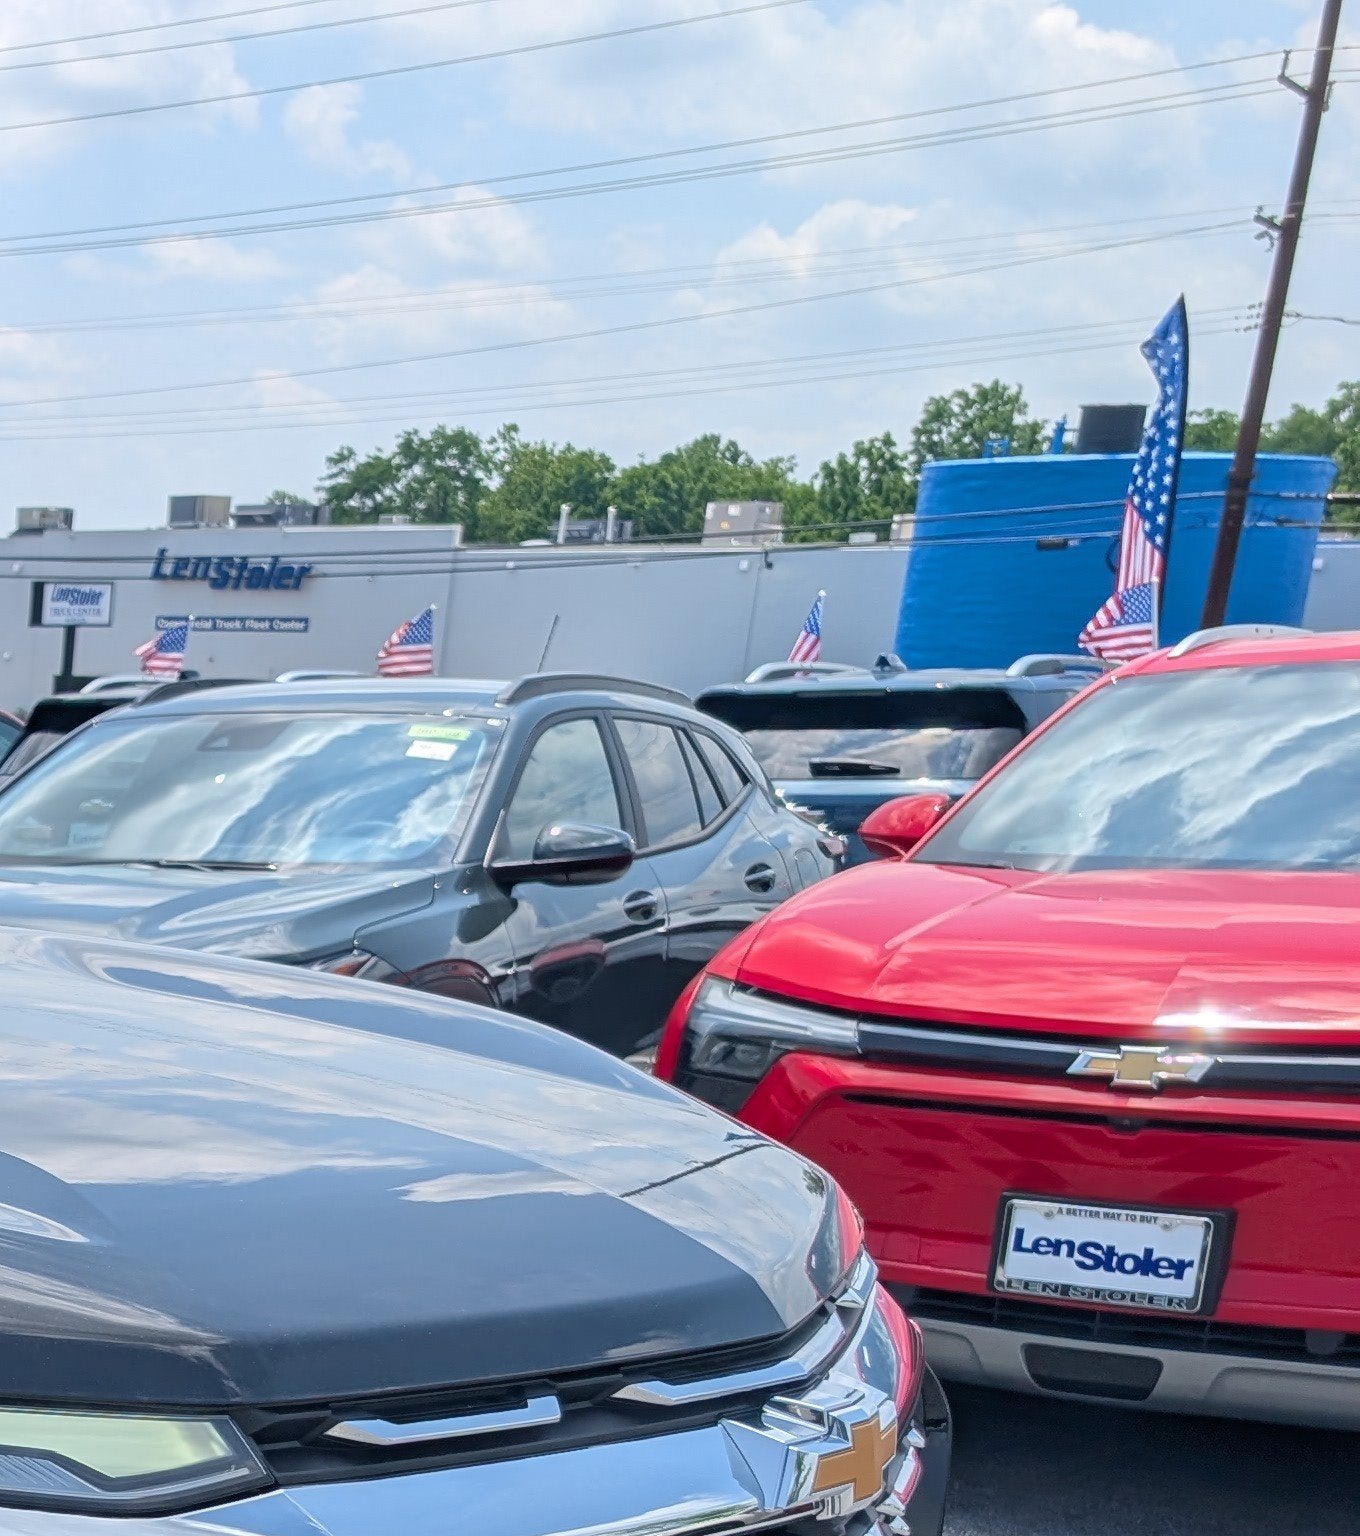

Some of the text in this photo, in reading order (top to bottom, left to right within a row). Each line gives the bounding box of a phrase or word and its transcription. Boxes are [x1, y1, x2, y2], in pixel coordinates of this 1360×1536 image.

[150, 548, 311, 590] LenStoler
[272, 619, 306, 631] Center
[1056, 1207, 1159, 1225] A BETTER WAY TO BUY
[1013, 1227, 1194, 1281] LenStoler
[1005, 1279, 1188, 1310] LEN STOLER
